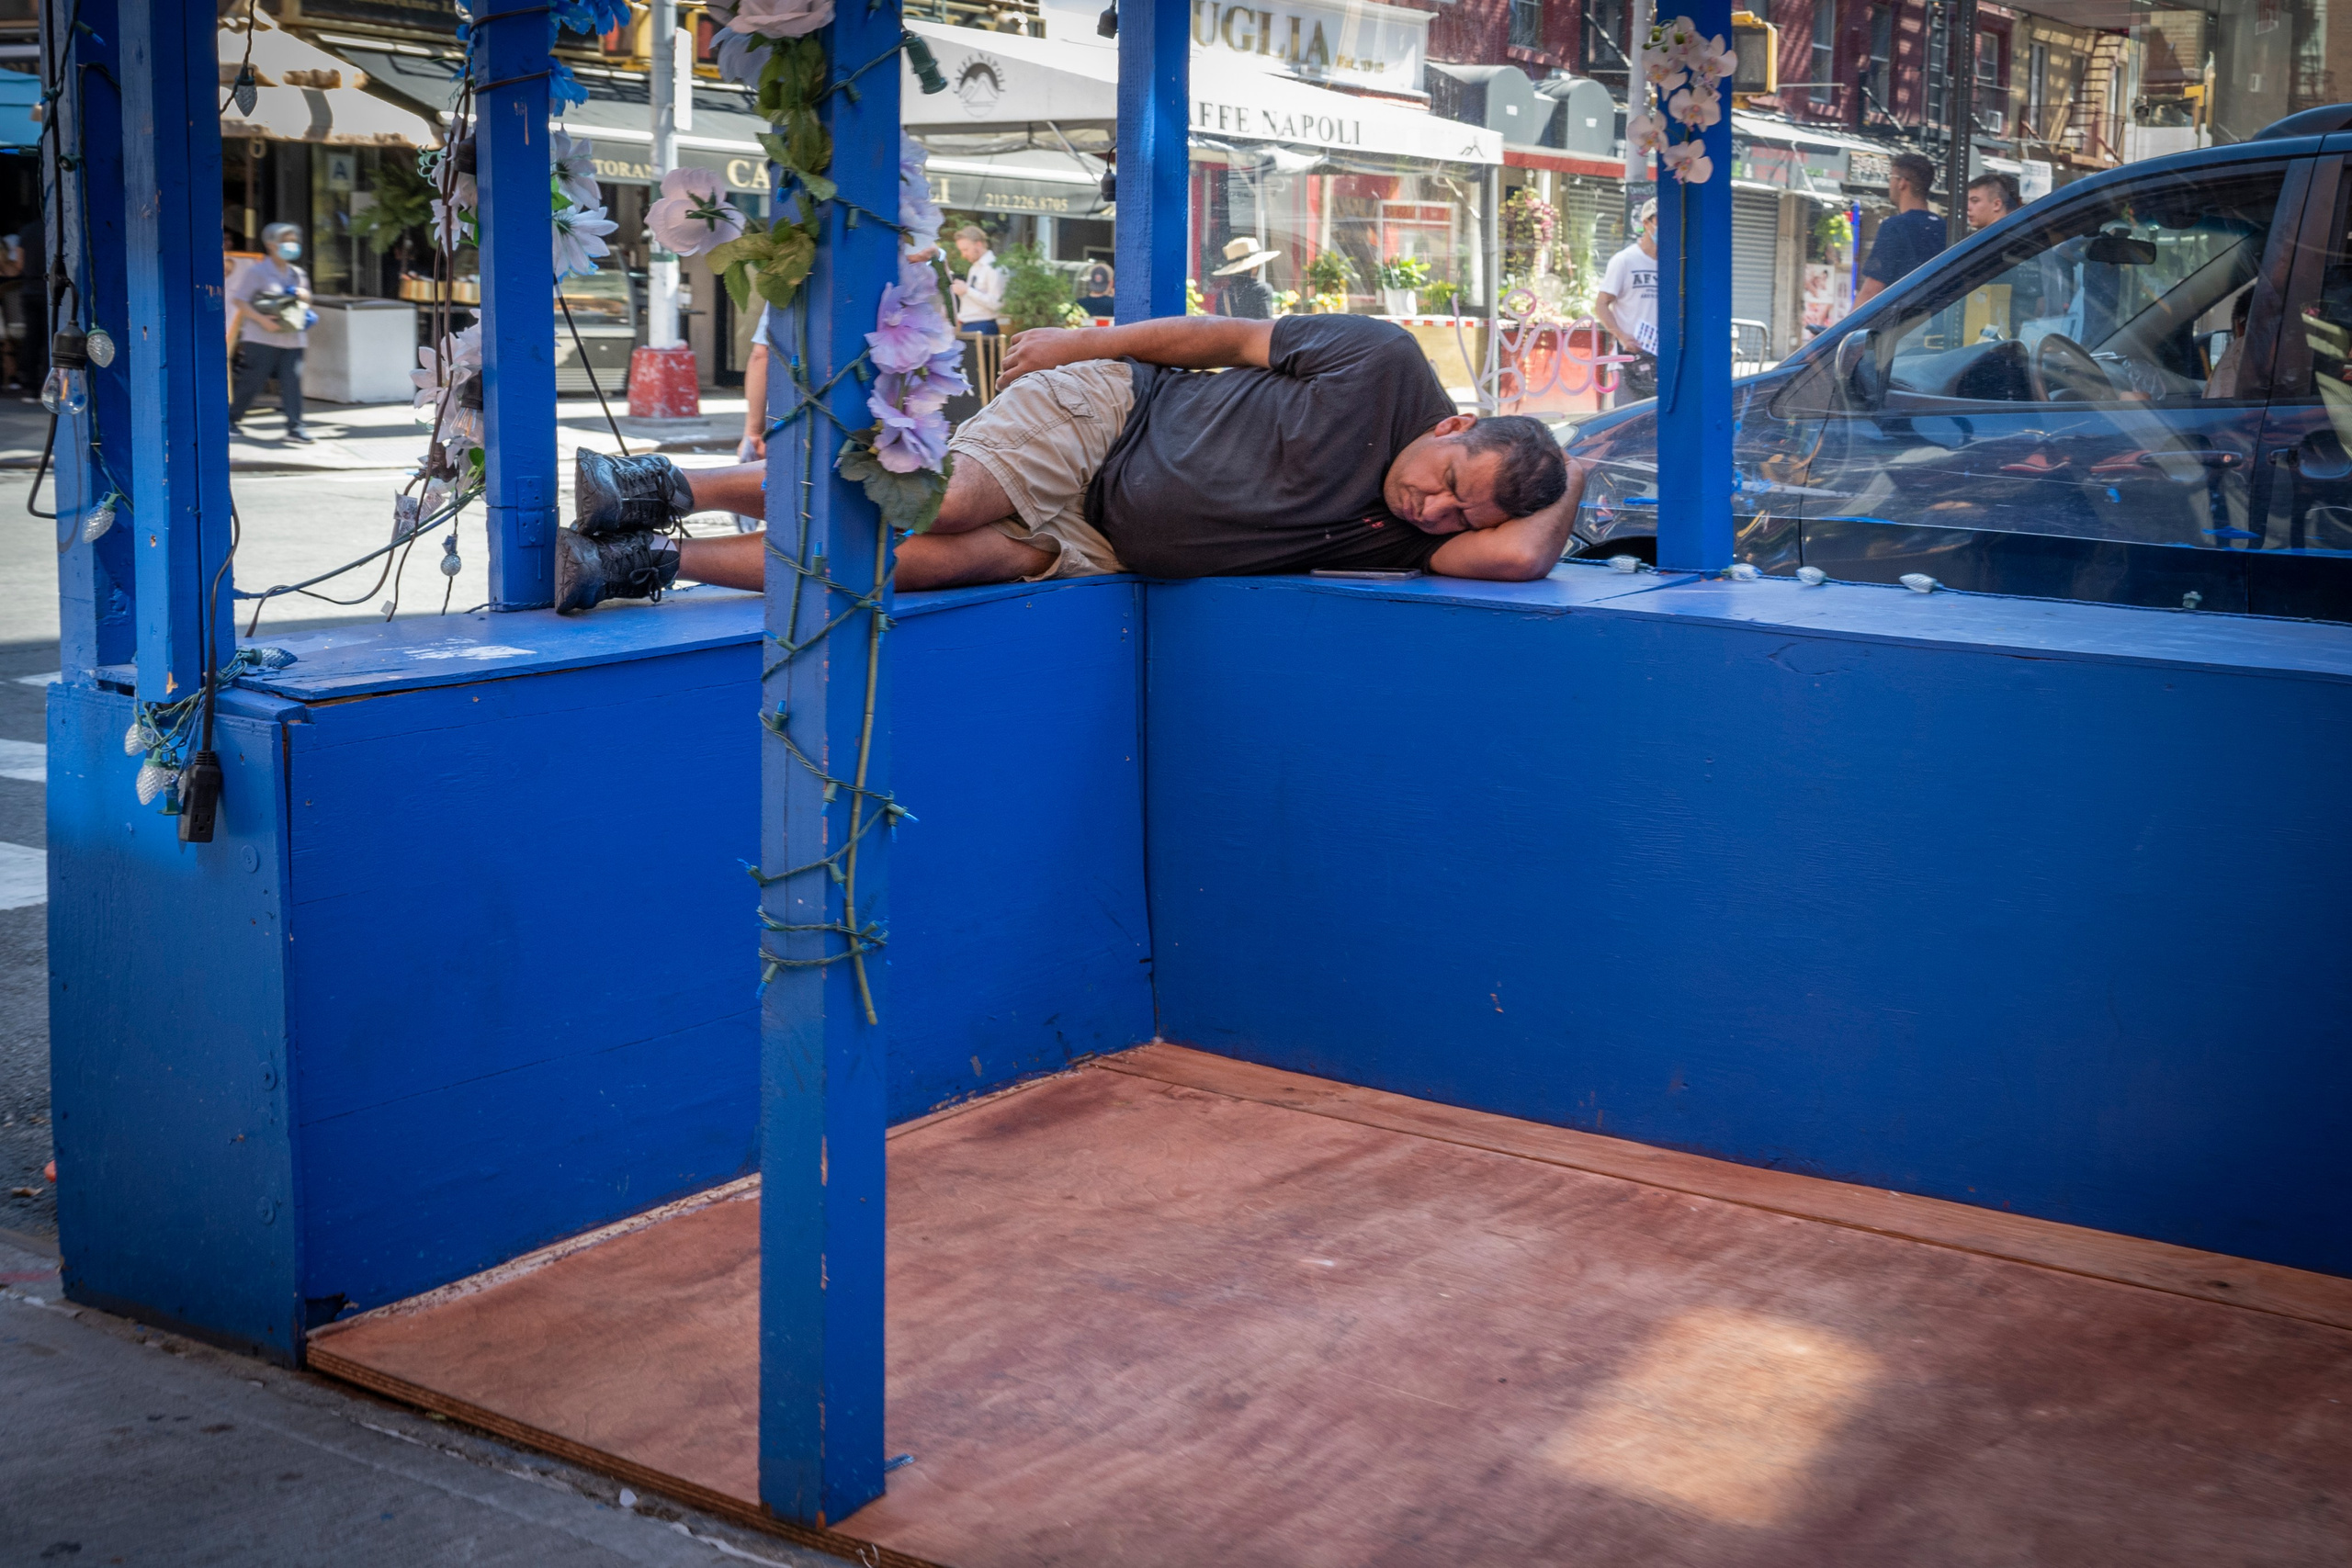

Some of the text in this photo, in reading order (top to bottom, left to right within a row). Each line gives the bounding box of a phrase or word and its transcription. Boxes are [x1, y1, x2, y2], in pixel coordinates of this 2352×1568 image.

[1192, 1, 1330, 65] UGLIA
[1190, 102, 1361, 145] FFE NAPOLI
[333, 161, 348, 180] A
[985, 193, 1069, 212] 212.226.8705
